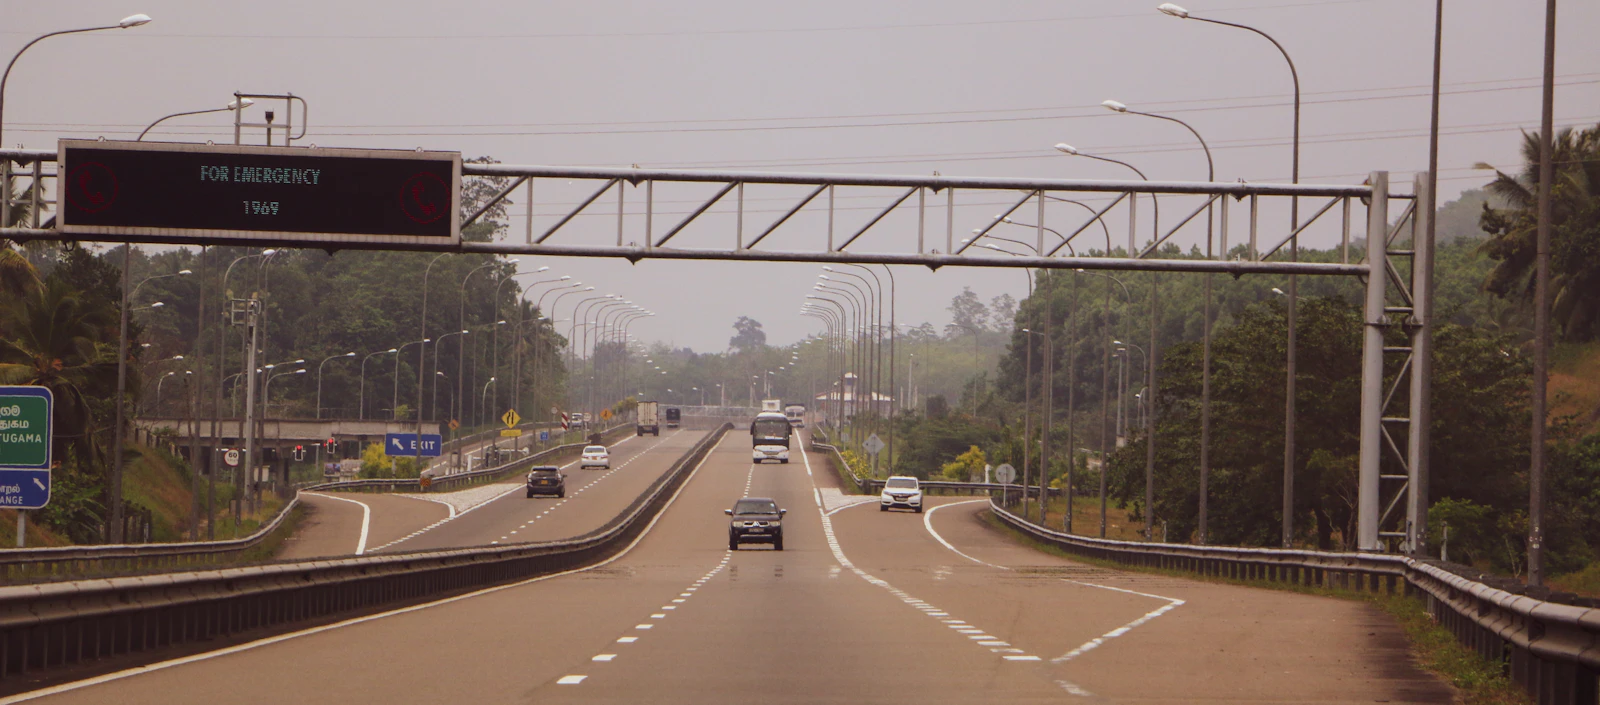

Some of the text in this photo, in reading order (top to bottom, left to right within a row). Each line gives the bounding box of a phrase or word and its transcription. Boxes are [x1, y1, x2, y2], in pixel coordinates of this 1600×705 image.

[200, 165, 321, 185] FOR EMERGENCY
[243, 200, 279, 215] 1969
[410, 440, 435, 450] EXIT
